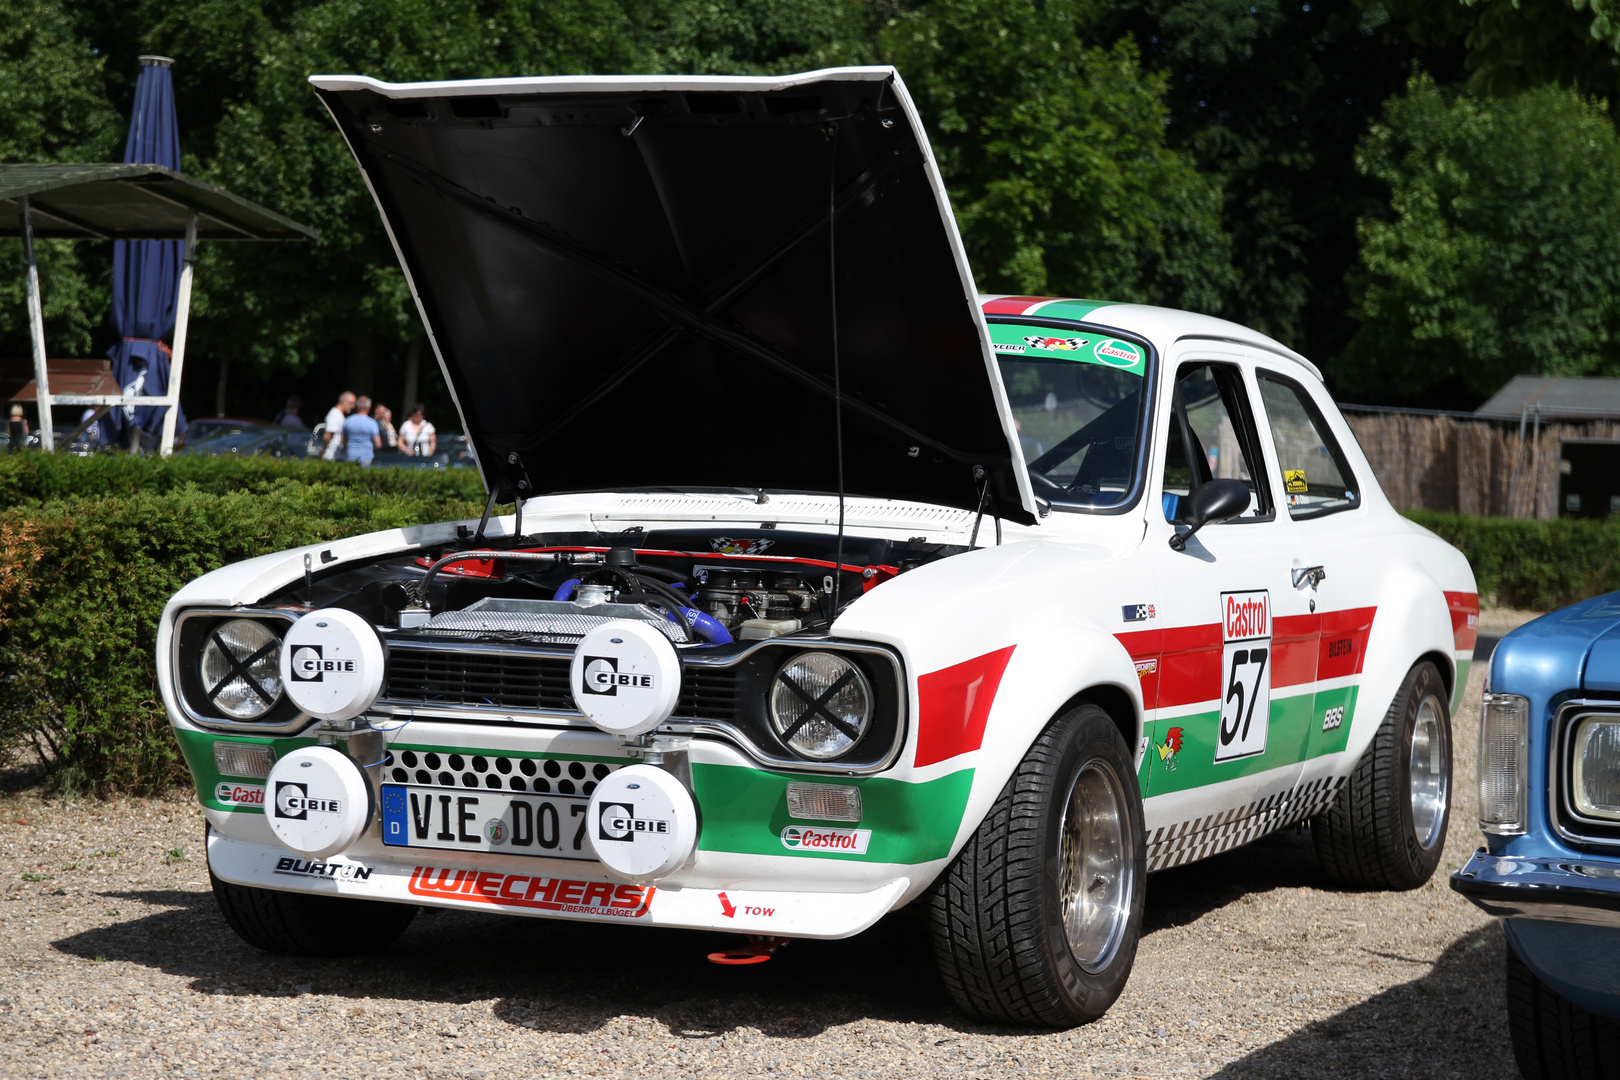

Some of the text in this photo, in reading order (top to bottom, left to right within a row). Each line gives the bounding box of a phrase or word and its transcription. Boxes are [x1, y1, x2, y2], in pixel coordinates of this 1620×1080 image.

[1101, 347, 1137, 361] Castrol
[1226, 595, 1267, 638] Castrol
[1328, 638, 1353, 658] BILSTEIN
[1220, 648, 1268, 745] 57
[1322, 705, 1344, 732] BBS
[232, 786, 265, 804] Castr
[391, 821, 400, 835] D
[410, 792, 482, 844] VIE
[510, 800, 560, 850] DO
[802, 830, 858, 850] Castrol
[276, 857, 374, 880] BURTON
[421, 866, 644, 911] WIECHERS
[561, 902, 636, 918] ÜBERROLLBÜGEL
[744, 906, 776, 918] TOW
